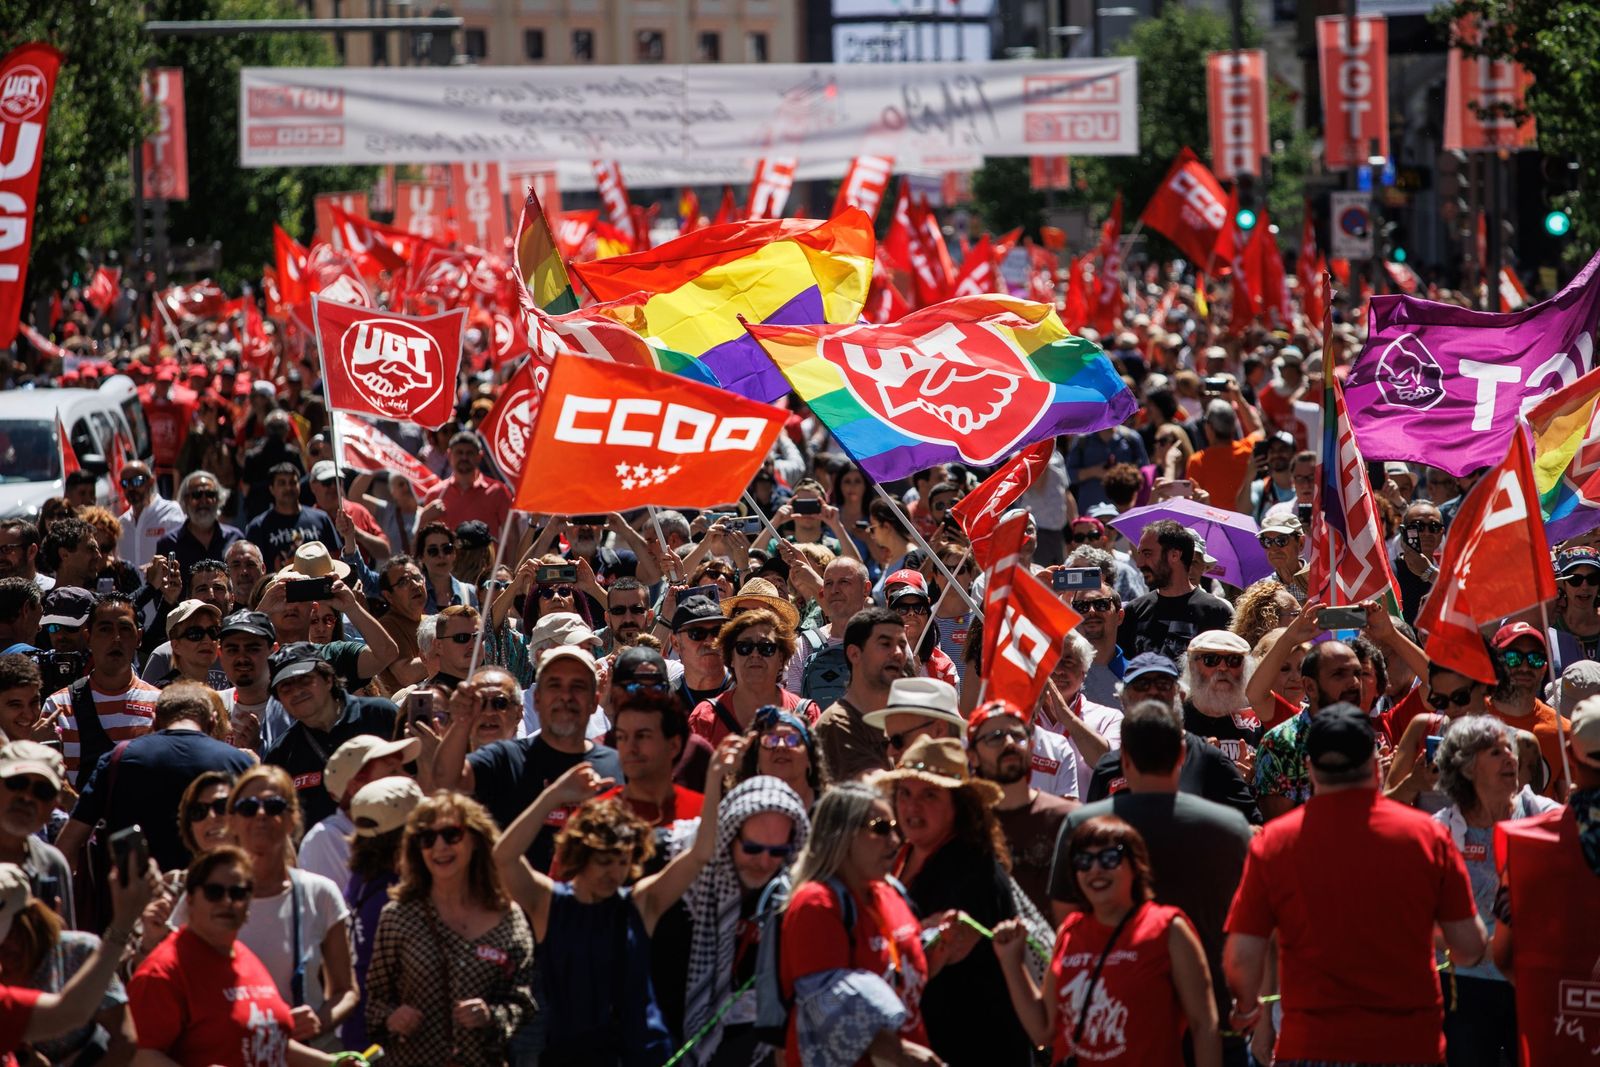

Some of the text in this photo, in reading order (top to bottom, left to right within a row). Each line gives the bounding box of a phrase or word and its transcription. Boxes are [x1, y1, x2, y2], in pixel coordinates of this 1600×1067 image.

[3, 77, 40, 96] UGT
[1337, 22, 1371, 140] UGT
[354, 323, 431, 374] UGT
[841, 322, 976, 388] UGT
[553, 394, 768, 454] CCOO
[126, 703, 153, 713] CCOO
[1032, 756, 1058, 769] CCOO
[293, 775, 309, 788] GT
[1062, 952, 1093, 968] UGT
